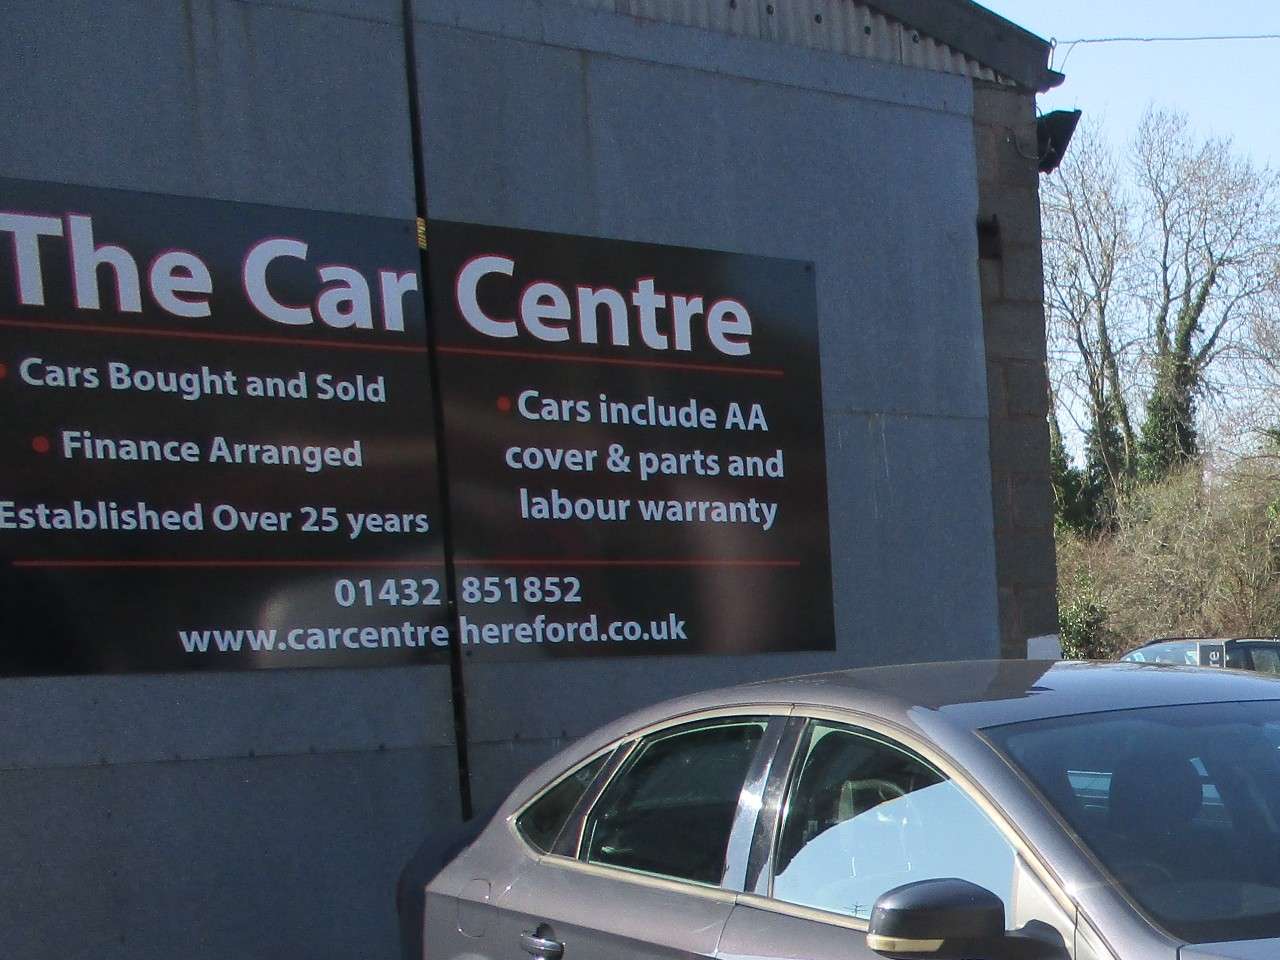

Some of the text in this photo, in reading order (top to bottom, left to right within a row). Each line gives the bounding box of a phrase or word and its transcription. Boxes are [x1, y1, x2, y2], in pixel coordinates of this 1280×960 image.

[0, 211, 753, 356] The Car Centre
[20, 357, 387, 403] Cars Bought and Sold
[517, 390, 769, 432] Cars include AA
[62, 430, 363, 473] Finance Arranged
[505, 443, 784, 481] cover & parts and
[0, 501, 430, 540] Established Over 25 years
[520, 488, 778, 531] labour warranty
[335, 576, 582, 607] 01432 851852
